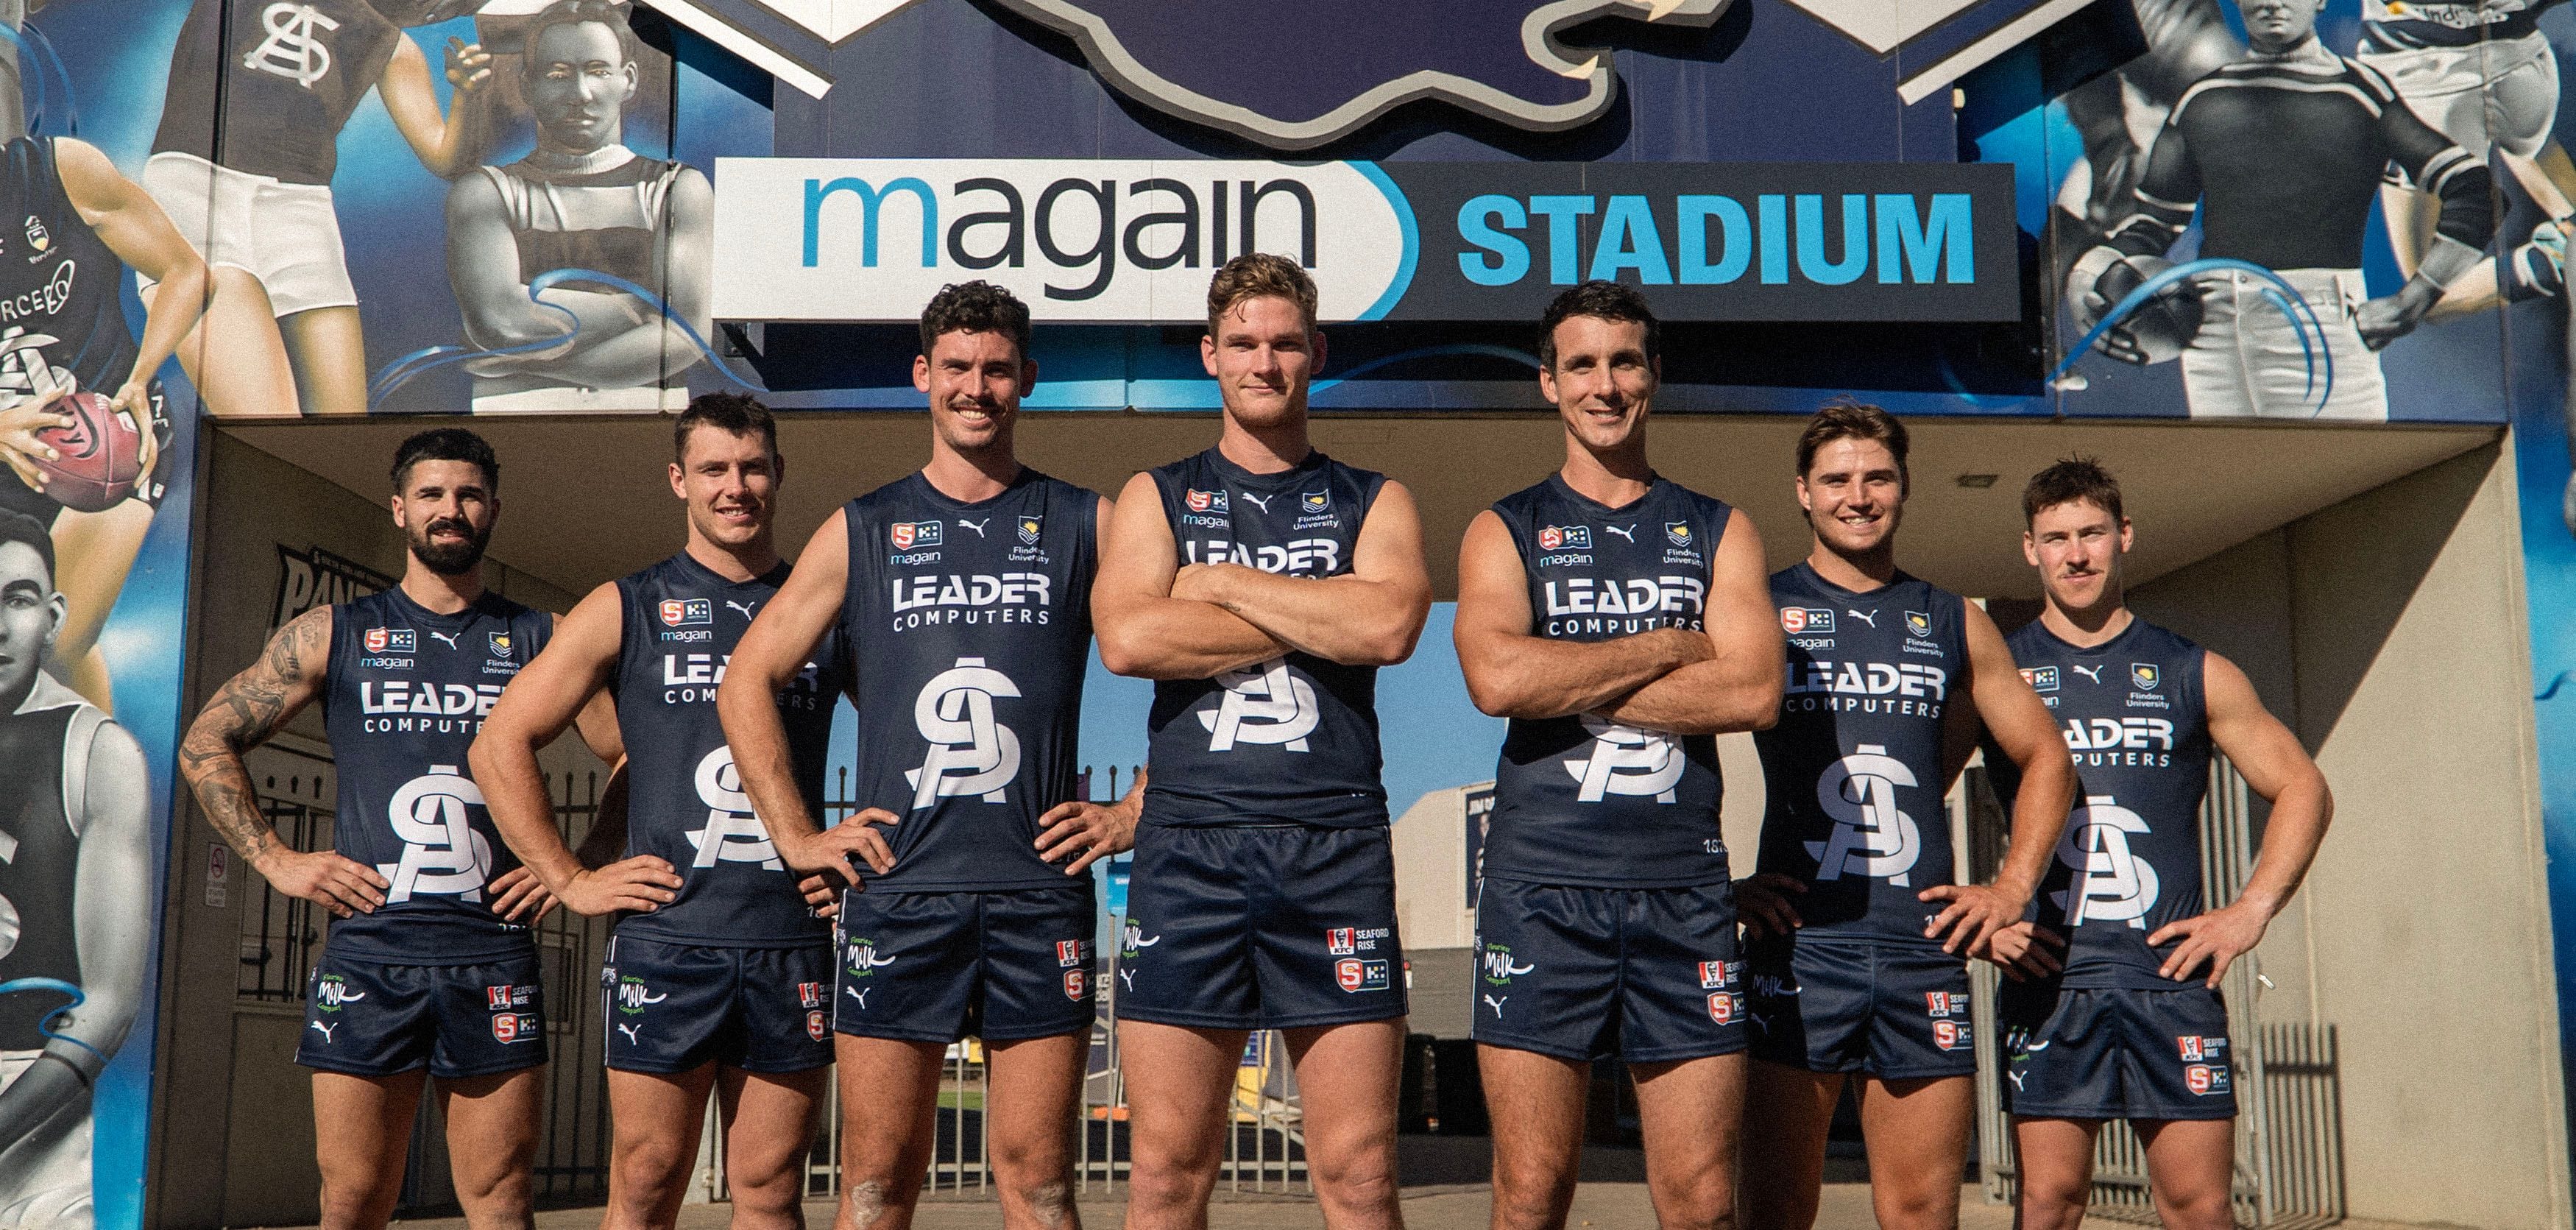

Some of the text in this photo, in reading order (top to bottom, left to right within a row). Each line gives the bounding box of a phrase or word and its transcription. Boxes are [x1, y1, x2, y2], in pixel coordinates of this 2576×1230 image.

[802, 177, 1975, 301] magain STADIUM
[1293, 520, 1340, 531] University
[1298, 513, 1334, 523] Flinders
[891, 552, 941, 565] magain
[1186, 538, 1340, 574] LEADER
[1540, 554, 1593, 568] magain
[893, 573, 1051, 613] LEADER
[1546, 576, 1705, 617] LEADER
[894, 609, 1049, 632] COMPUTERS
[661, 630, 712, 643] magain
[1906, 637, 1939, 649] Flinders
[1903, 645, 1944, 659] University
[361, 657, 414, 670] magain
[1786, 662, 1947, 701] LEADER
[361, 681, 507, 715] LEADE
[2130, 692, 2165, 701] Flinders
[1787, 697, 1941, 719] COMPUTERS
[2126, 699, 2170, 710] University
[2062, 717, 2174, 751] ADER
[2072, 752, 2170, 767] PUTERS
[1356, 927, 1390, 940] SEAFORD
[1357, 940, 1376, 950] RISE
[847, 944, 896, 969] Milk
[1485, 951, 1535, 978] Milk
[318, 981, 365, 1005] Milk
[513, 996, 529, 1005] RISE
[619, 983, 667, 1008] Milk
